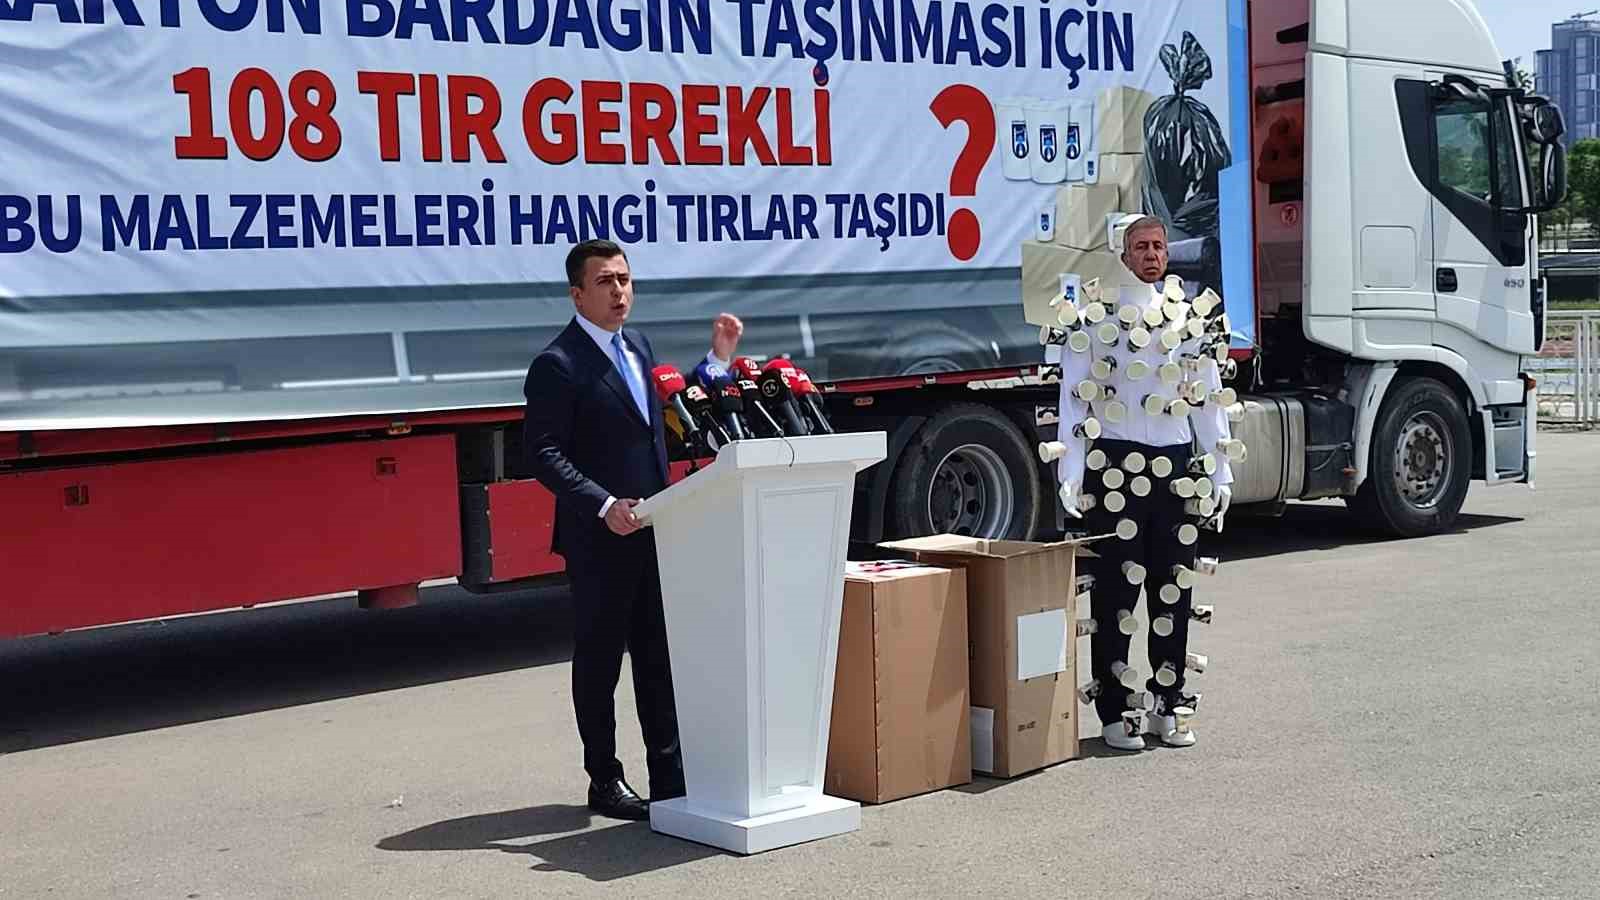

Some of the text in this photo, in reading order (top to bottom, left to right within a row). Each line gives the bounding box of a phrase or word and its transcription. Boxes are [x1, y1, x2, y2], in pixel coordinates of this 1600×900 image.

[173, 67, 342, 163] 108
[357, 71, 507, 164] TIR
[0, 194, 82, 253] BU
[100, 178, 496, 252] MALZEMELERİ
[667, 193, 818, 242] TIRLAR
